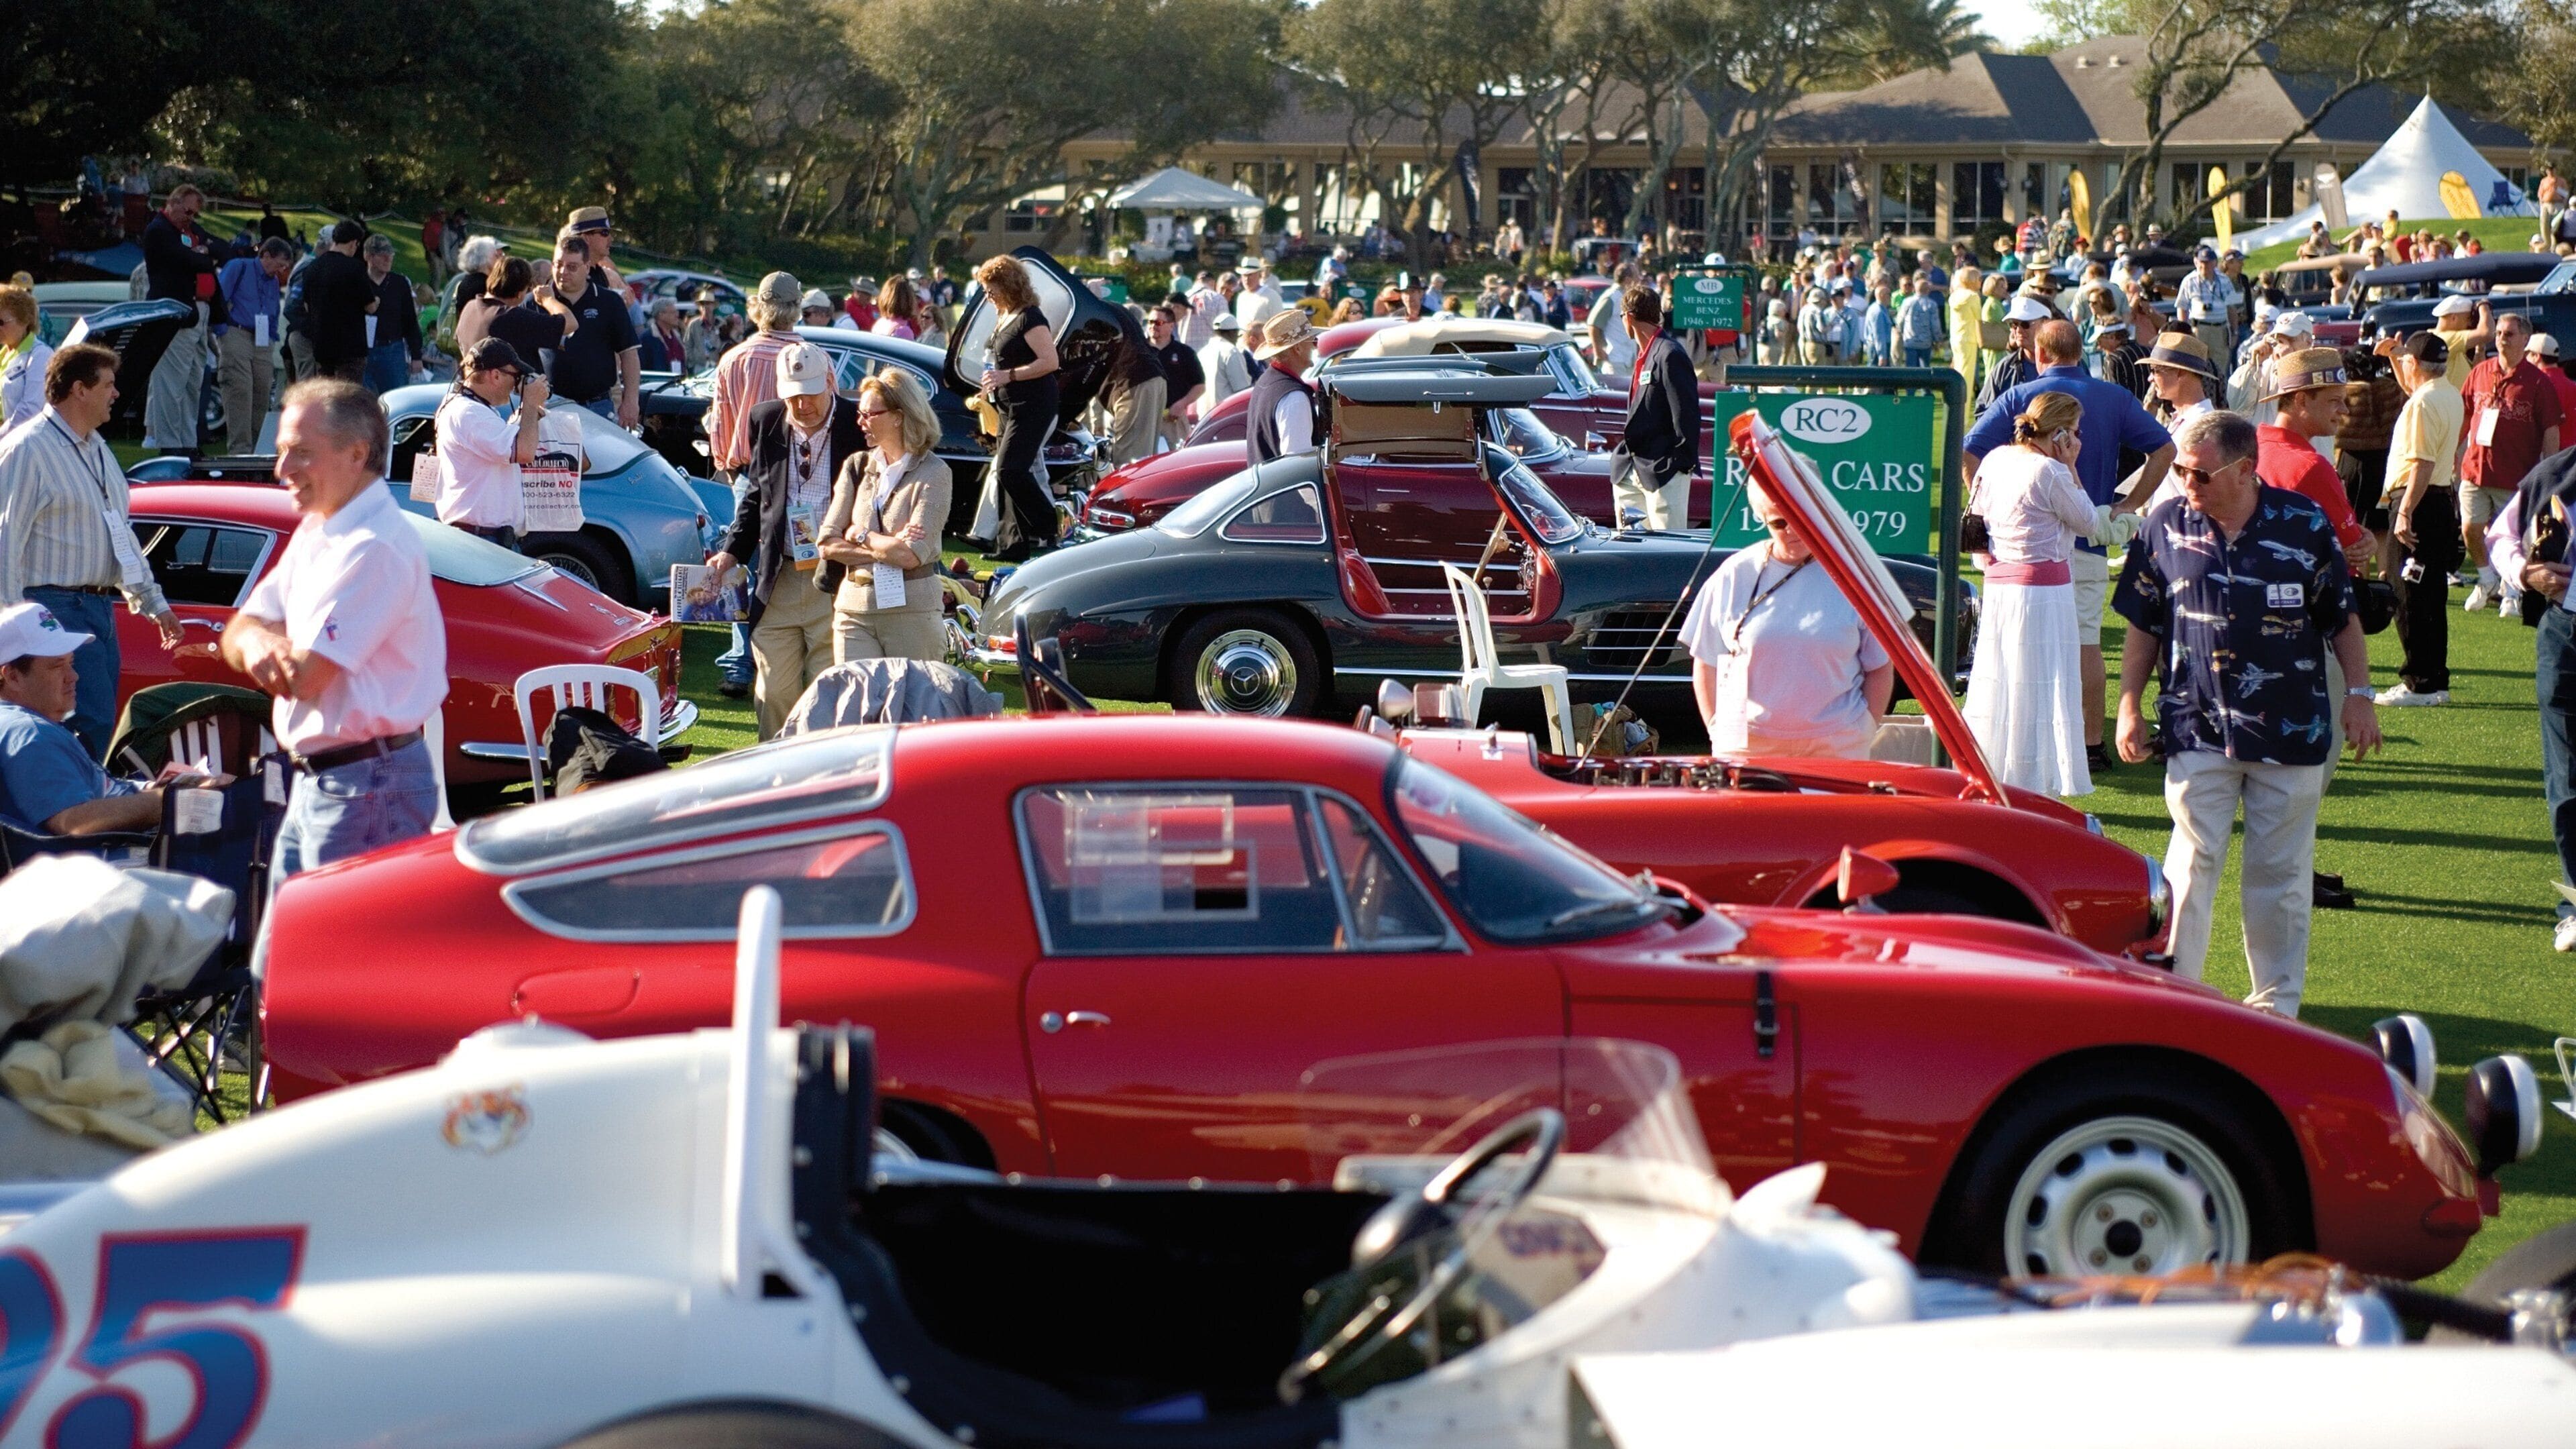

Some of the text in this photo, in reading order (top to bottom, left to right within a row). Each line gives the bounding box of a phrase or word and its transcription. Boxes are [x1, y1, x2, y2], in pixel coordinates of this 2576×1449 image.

[1701, 282, 1718, 290] MB
[1682, 296, 1733, 305] MERCEDES-
[1696, 306, 1720, 315] BENZ
[1683, 317, 1704, 326] 1946
[1712, 317, 1733, 327] 1972
[1793, 407, 1858, 433] RC2
[1831, 460, 1925, 493] CARS
[1845, 510, 1907, 538] 979
